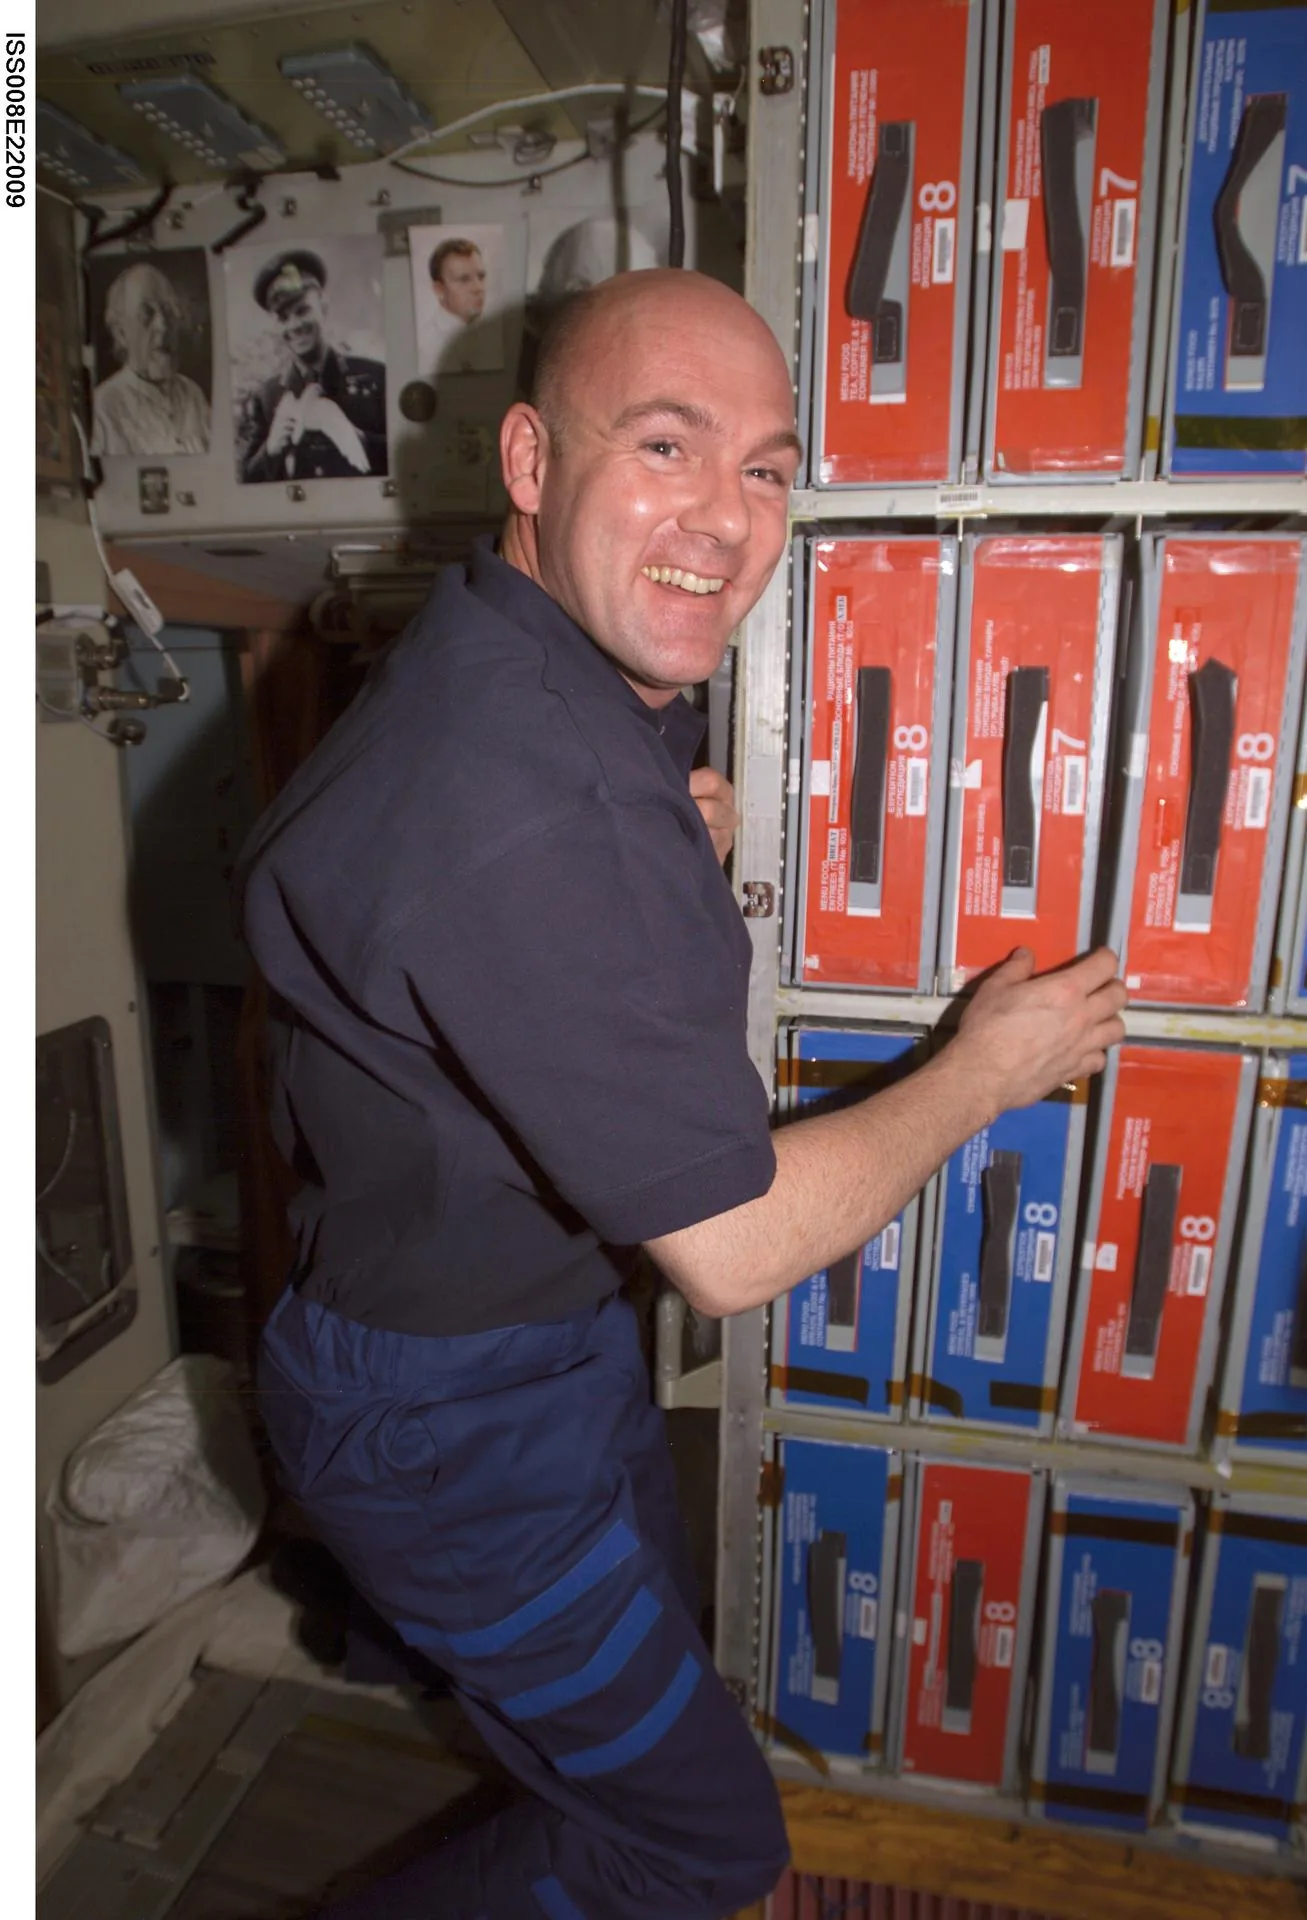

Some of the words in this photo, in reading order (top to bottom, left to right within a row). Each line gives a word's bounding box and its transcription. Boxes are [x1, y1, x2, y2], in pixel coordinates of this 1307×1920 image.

[1100, 167, 1137, 198] 7
[919, 180, 957, 212] 8
[840, 342, 849, 370] FOOD
[894, 724, 928, 750] 8
[1053, 728, 1088, 756] 7
[1237, 732, 1275, 760] 8
[820, 859, 829, 884] FOOD
[819, 886, 828, 911] MENU
[827, 870, 838, 911] ENTREES
[836, 863, 846, 911] CONTAINER
[1025, 1202, 1057, 1227] 8
[1181, 1214, 1216, 1241] 8
[850, 1571, 878, 1593] 8
[985, 1601, 1016, 1622] 8
[1131, 1638, 1163, 1660] 8
[1202, 1687, 1235, 1710] 8
